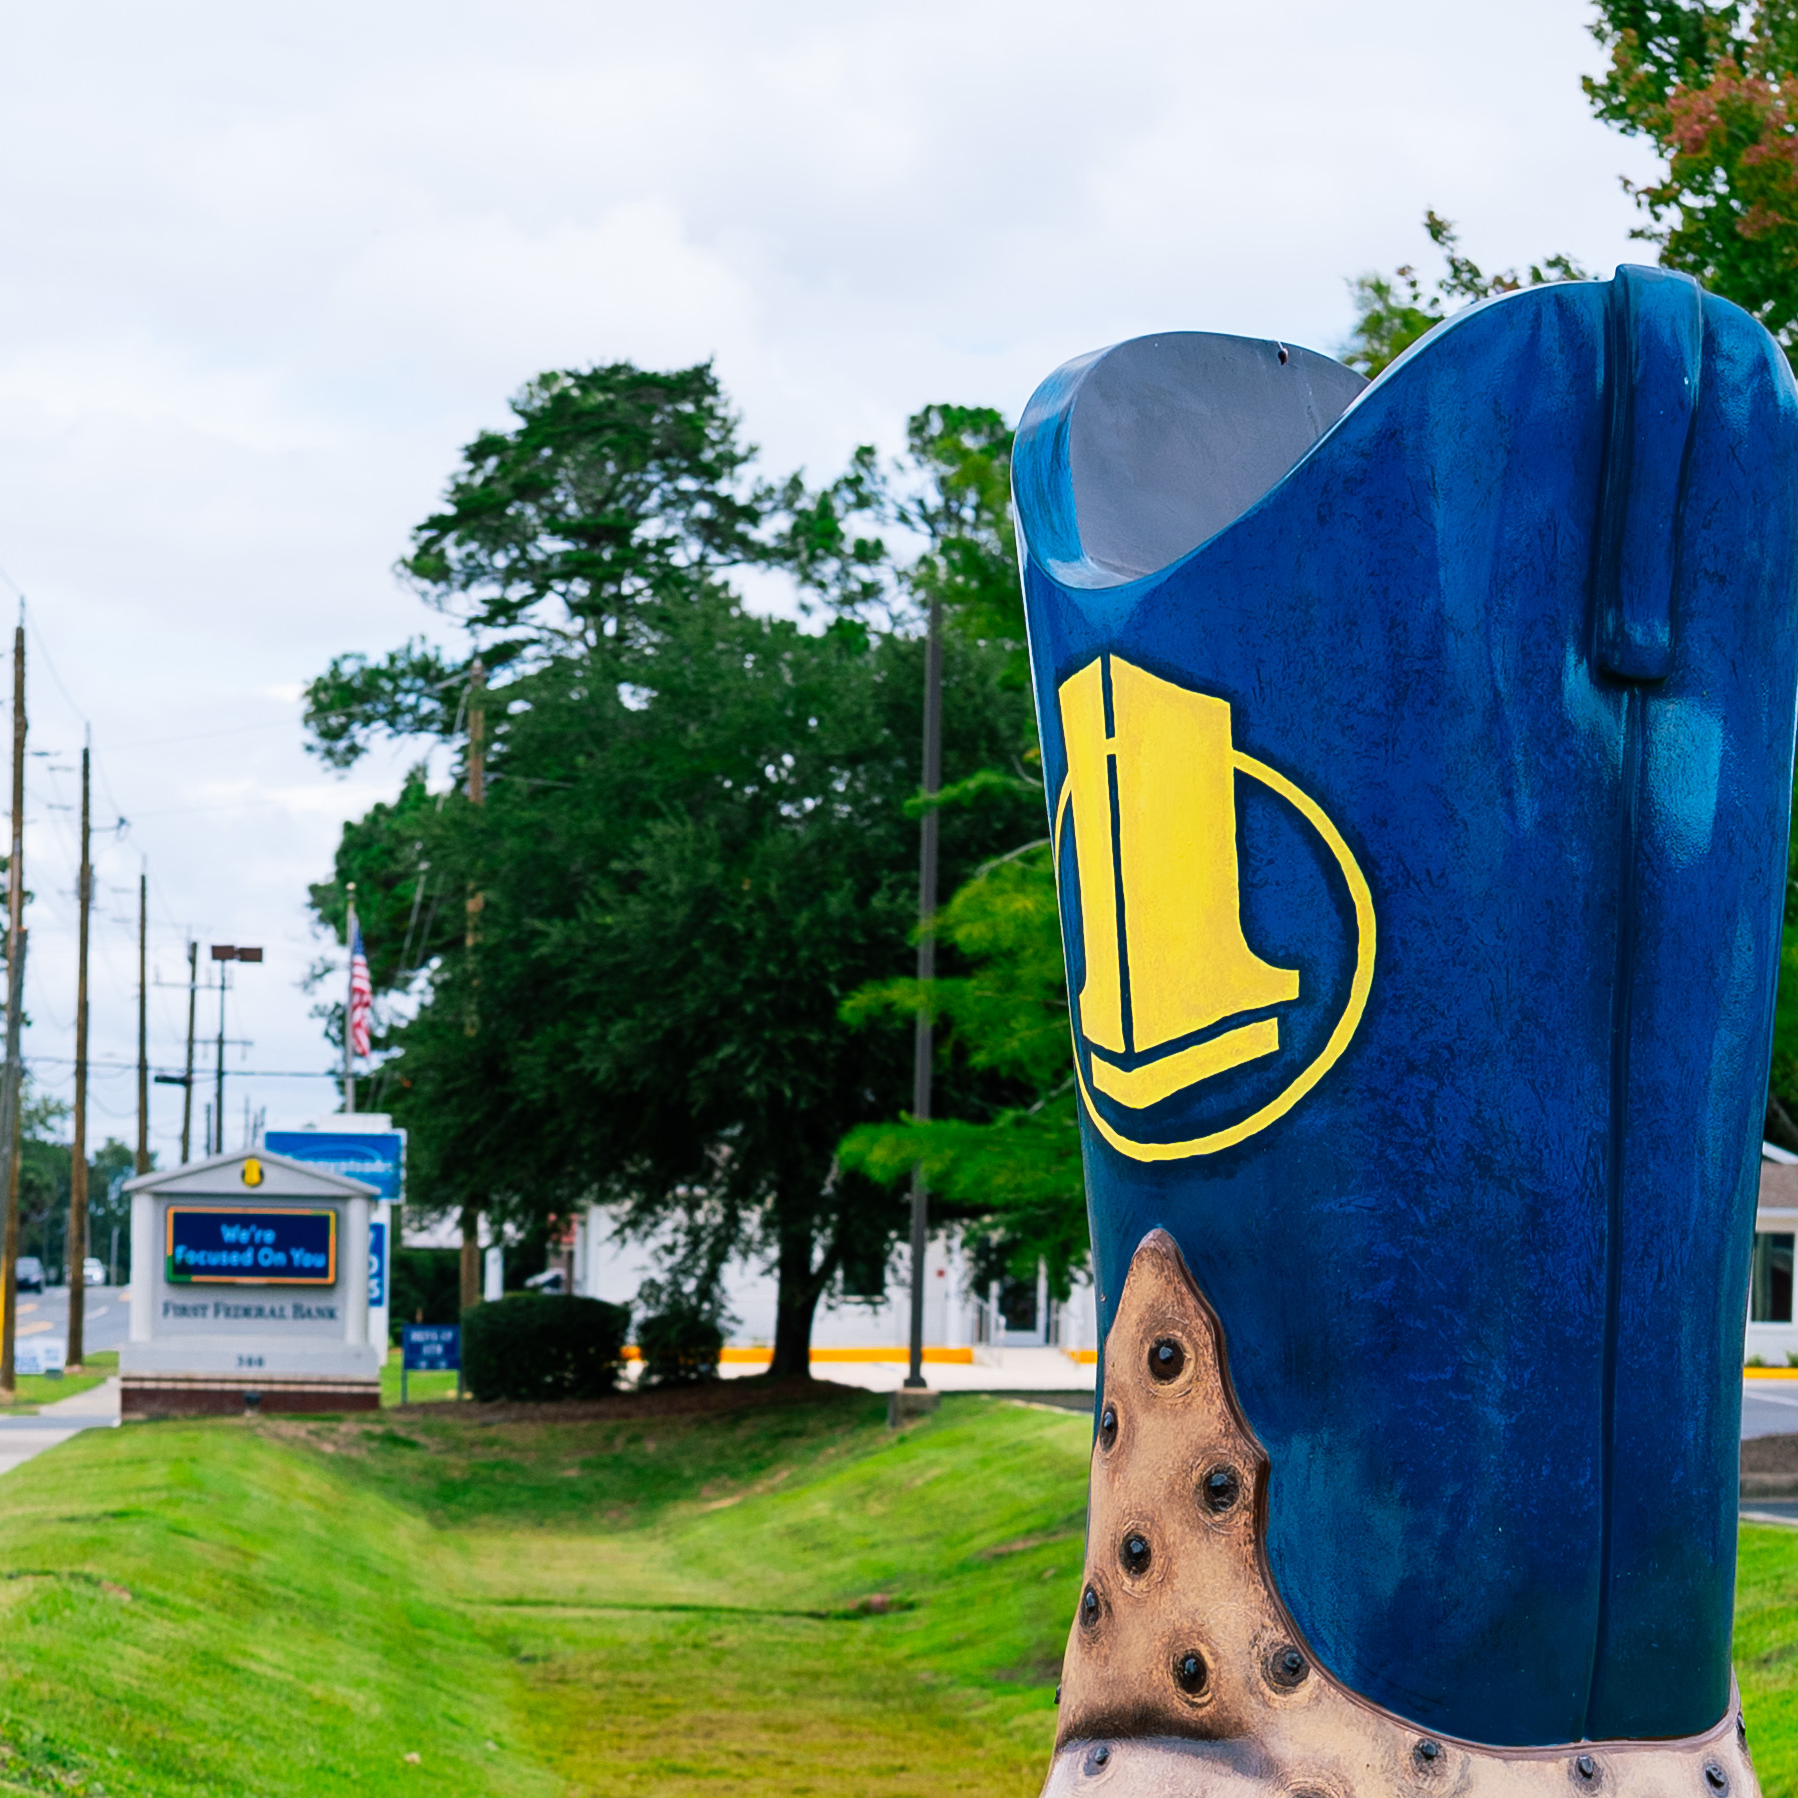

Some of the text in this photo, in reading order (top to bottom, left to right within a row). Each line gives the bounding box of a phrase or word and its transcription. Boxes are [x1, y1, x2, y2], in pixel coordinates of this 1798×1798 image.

[220, 1224, 276, 1244] We're
[175, 1245, 326, 1268] Focused On You
[162, 1301, 338, 1321] FIRST FEDERAL BANK
